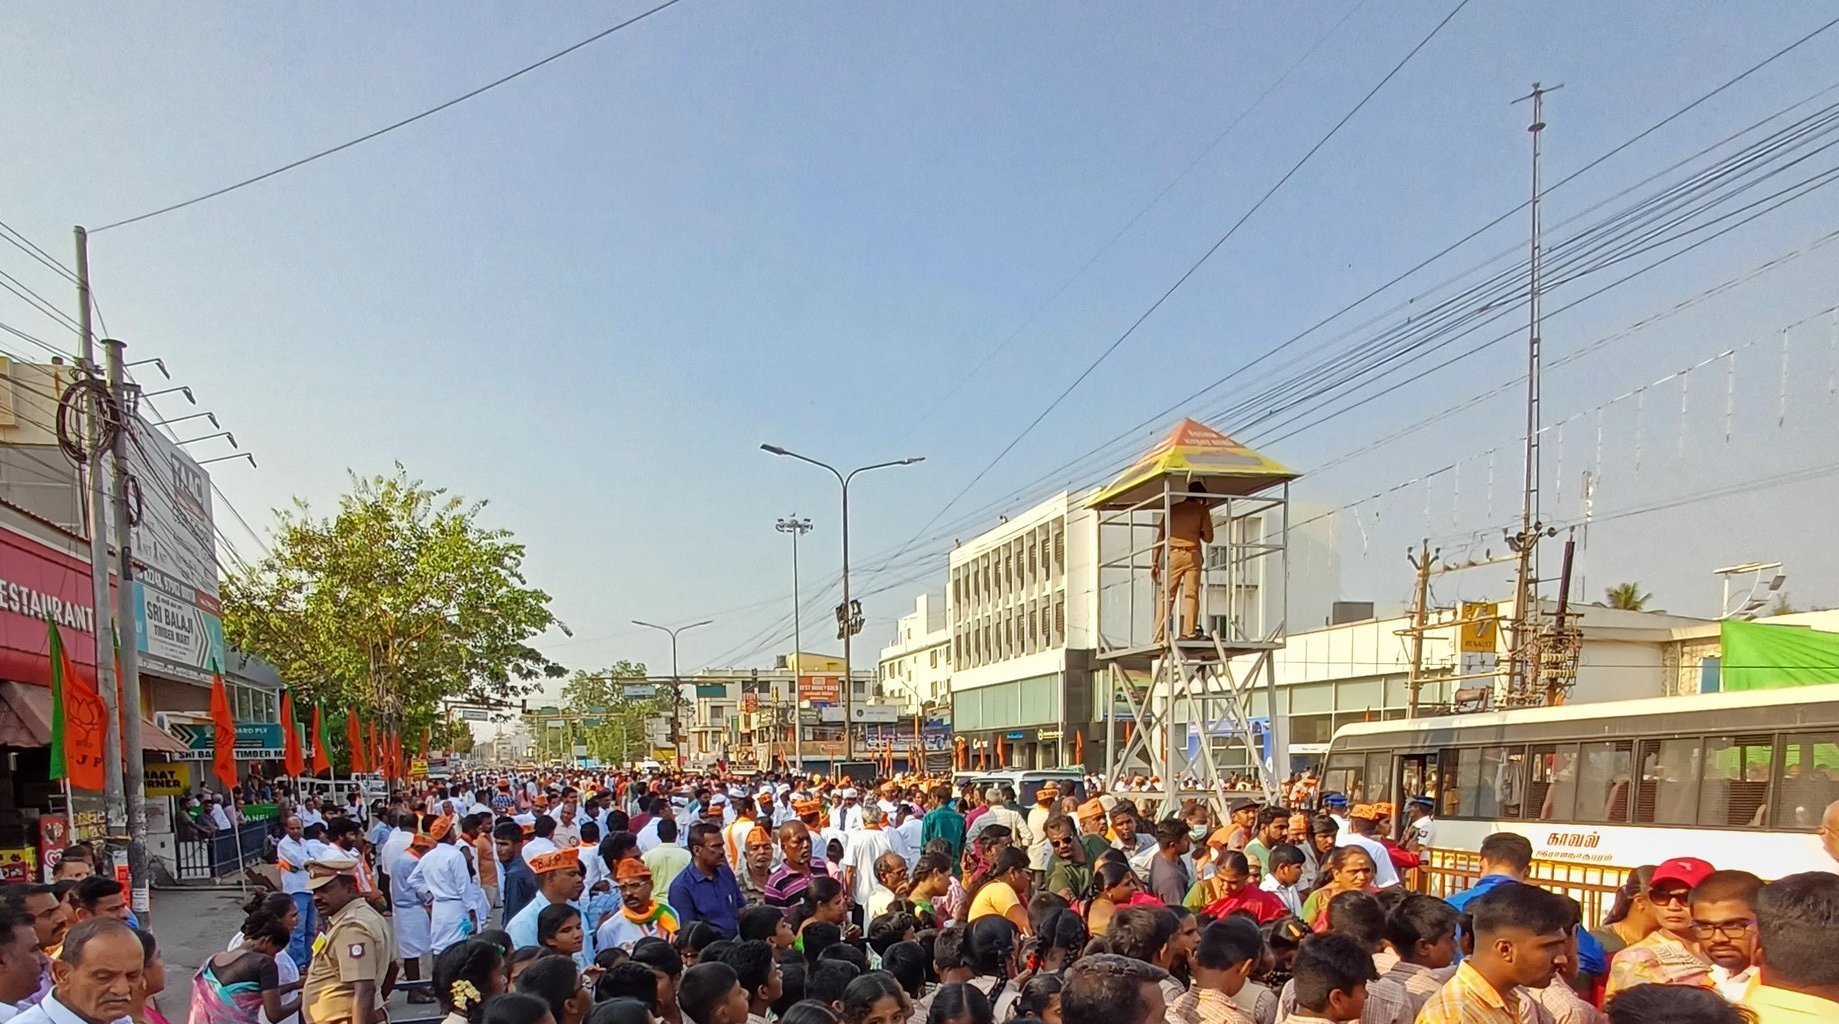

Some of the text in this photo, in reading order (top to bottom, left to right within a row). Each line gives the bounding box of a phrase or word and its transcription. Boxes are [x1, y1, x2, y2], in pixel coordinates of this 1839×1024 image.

[147, 601, 163, 623] SRI
[164, 607, 194, 635] BALAJI
[235, 750, 271, 758] TIMBER
[1547, 831, 1600, 848] காவல்
